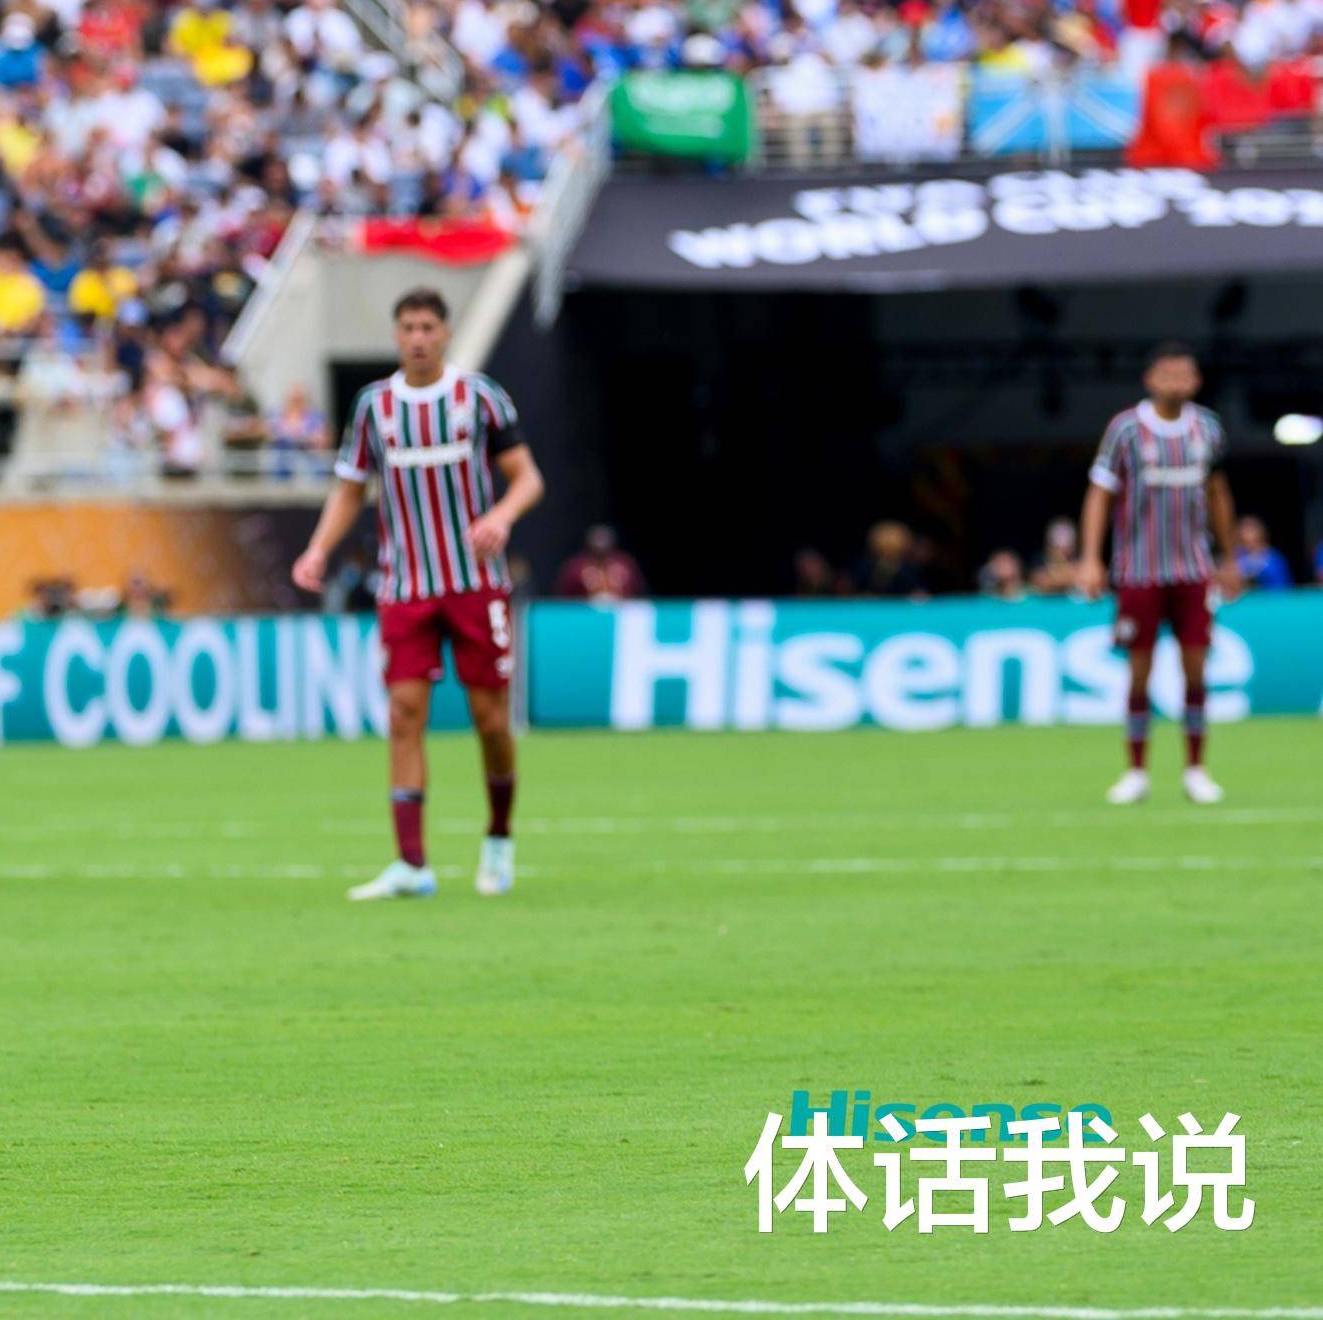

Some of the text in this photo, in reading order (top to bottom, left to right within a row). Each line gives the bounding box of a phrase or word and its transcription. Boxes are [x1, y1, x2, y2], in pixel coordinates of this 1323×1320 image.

[669, 208, 990, 268] WORLD
[992, 192, 1167, 234] CUP
[610, 598, 1254, 731] Hisense
